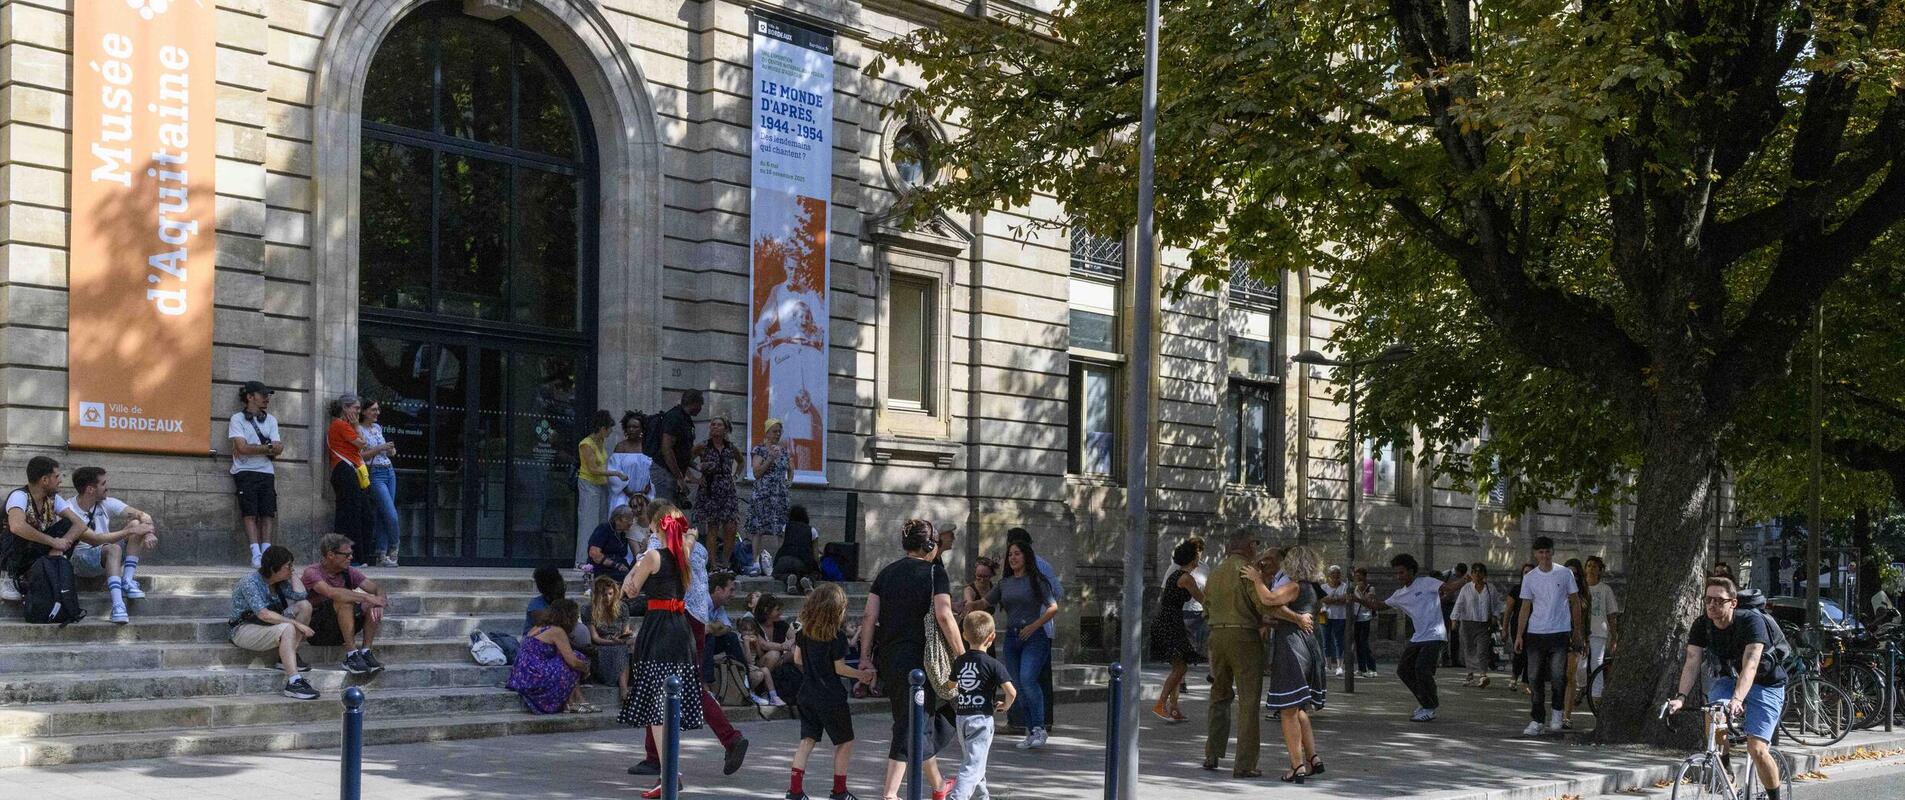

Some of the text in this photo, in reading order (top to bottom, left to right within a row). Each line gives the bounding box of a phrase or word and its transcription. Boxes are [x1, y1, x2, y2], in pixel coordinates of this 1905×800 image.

[768, 29, 793, 41] BORDEAUX
[761, 80, 823, 108] LE MONDE
[89, 33, 133, 188] Musée
[761, 97, 815, 124] D'APRÈS,
[760, 115, 789, 134] 1944
[797, 123, 823, 142] 1954
[760, 132, 811, 151] Des lendemains
[760, 143, 771, 153] qui
[773, 146, 801, 160] chantent
[109, 403, 143, 414] Ville de
[109, 415, 183, 433] BORDEAUX
